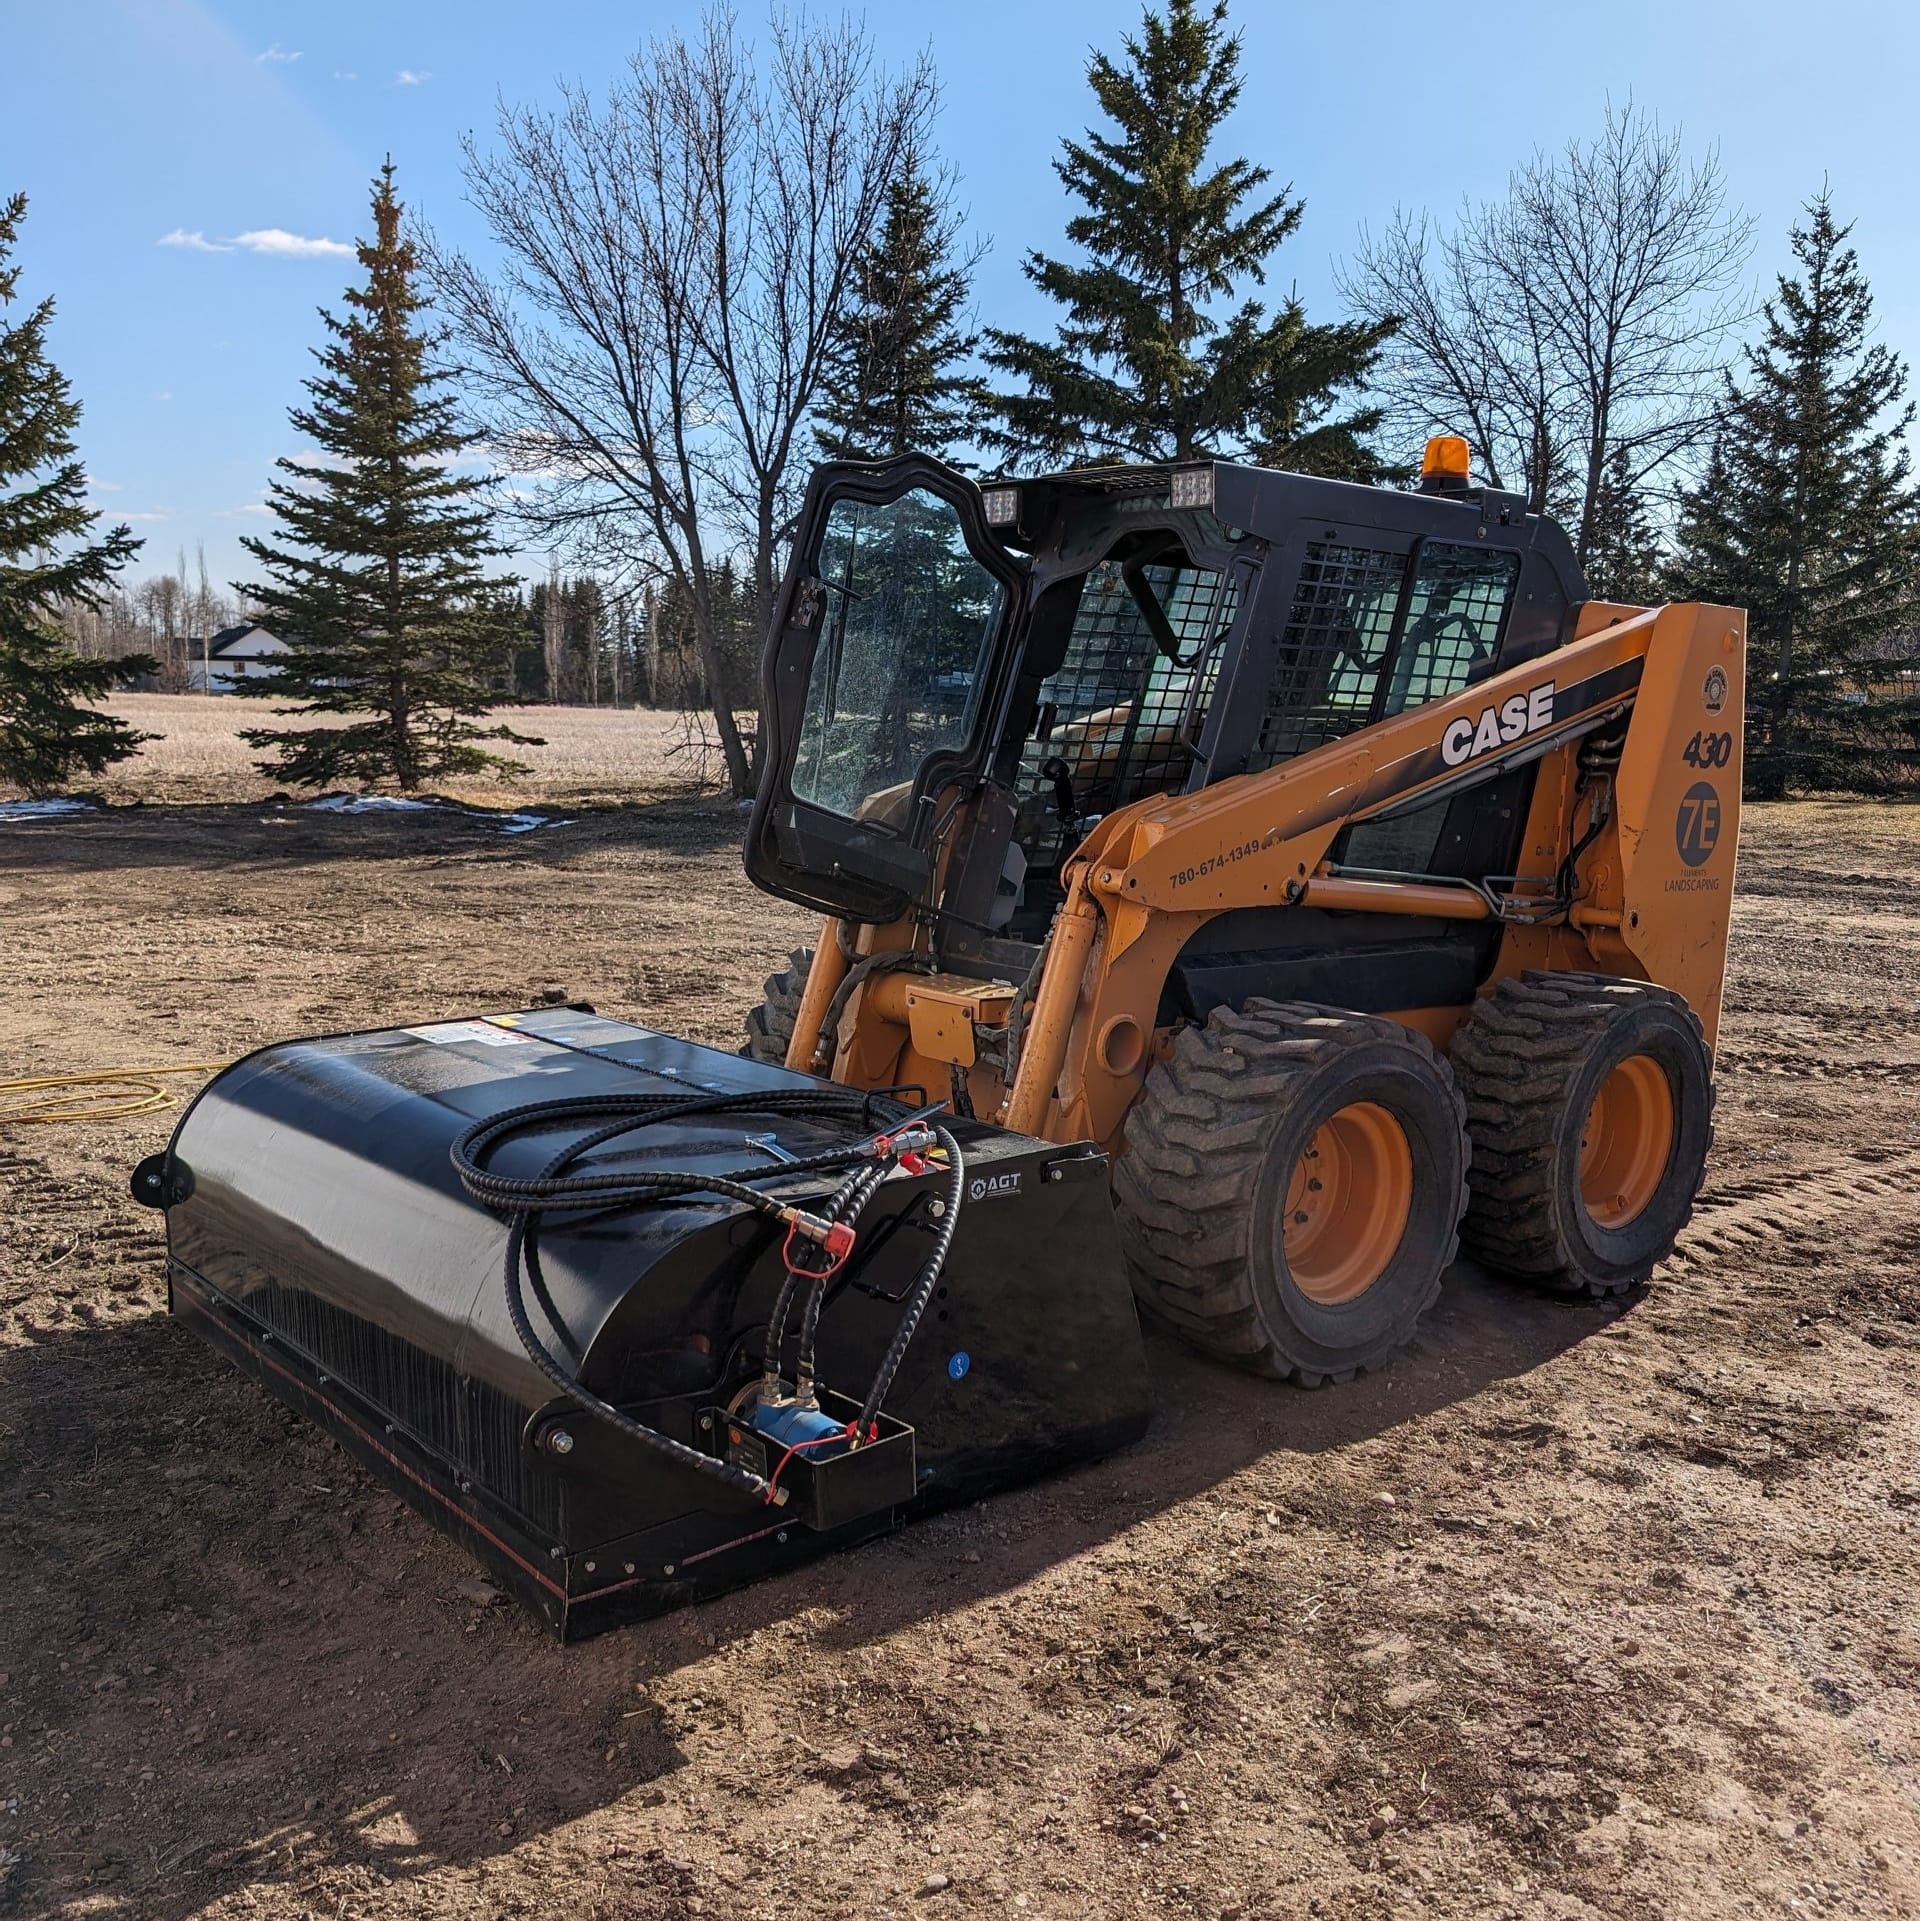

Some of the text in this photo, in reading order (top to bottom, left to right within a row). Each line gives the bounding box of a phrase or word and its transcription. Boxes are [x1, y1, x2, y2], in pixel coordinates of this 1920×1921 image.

[1441, 680, 1555, 766] CASE
[1682, 731, 1732, 768] 430
[1682, 799, 1718, 849] 7E
[1169, 839, 1260, 888] 780-674-1349
[1664, 878, 1719, 892] LANDSCAPING
[987, 1173, 1021, 1190] AGT
